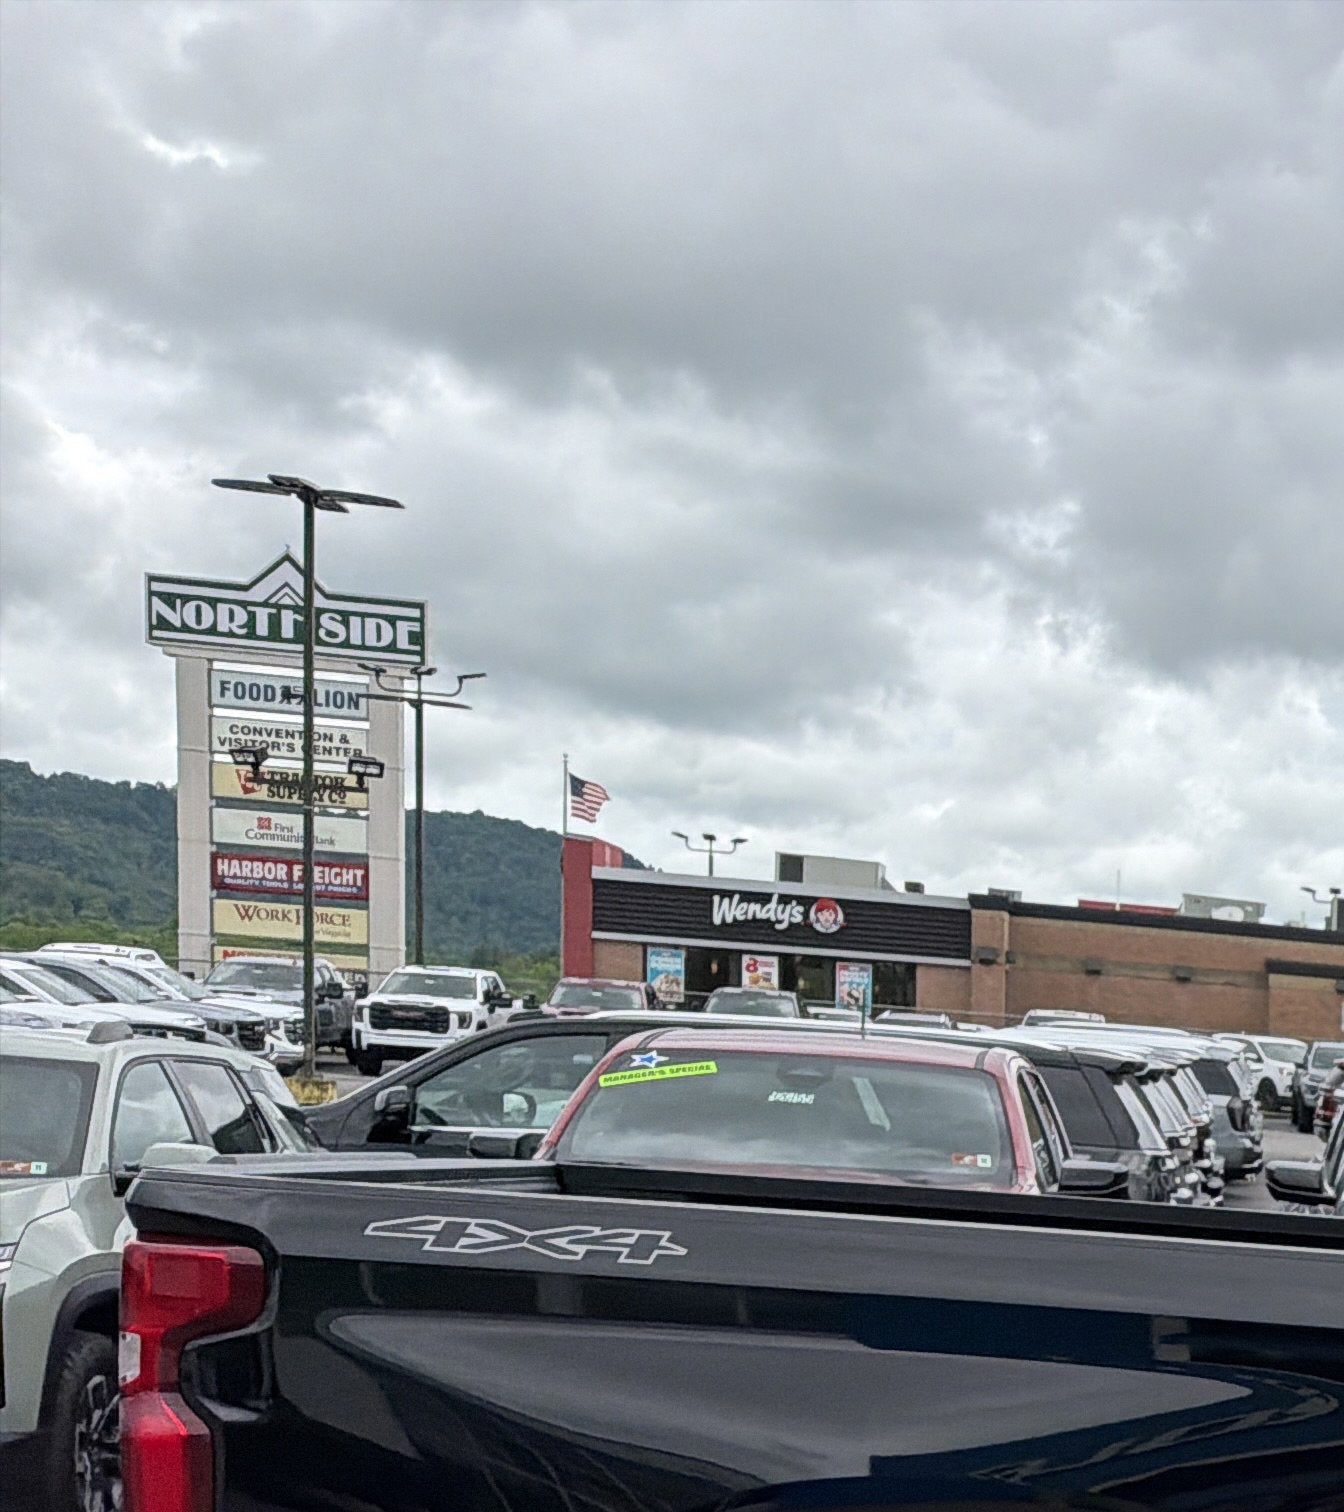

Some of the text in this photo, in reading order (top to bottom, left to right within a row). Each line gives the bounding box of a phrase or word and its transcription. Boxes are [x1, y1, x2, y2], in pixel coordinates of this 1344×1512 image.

[219, 680, 361, 710] FOOD LION
[228, 723, 350, 744] CONVENTON &
[301, 744, 363, 758] ENTER
[217, 858, 364, 887] HARBOR FEIGHT
[712, 893, 805, 930] Wendy's
